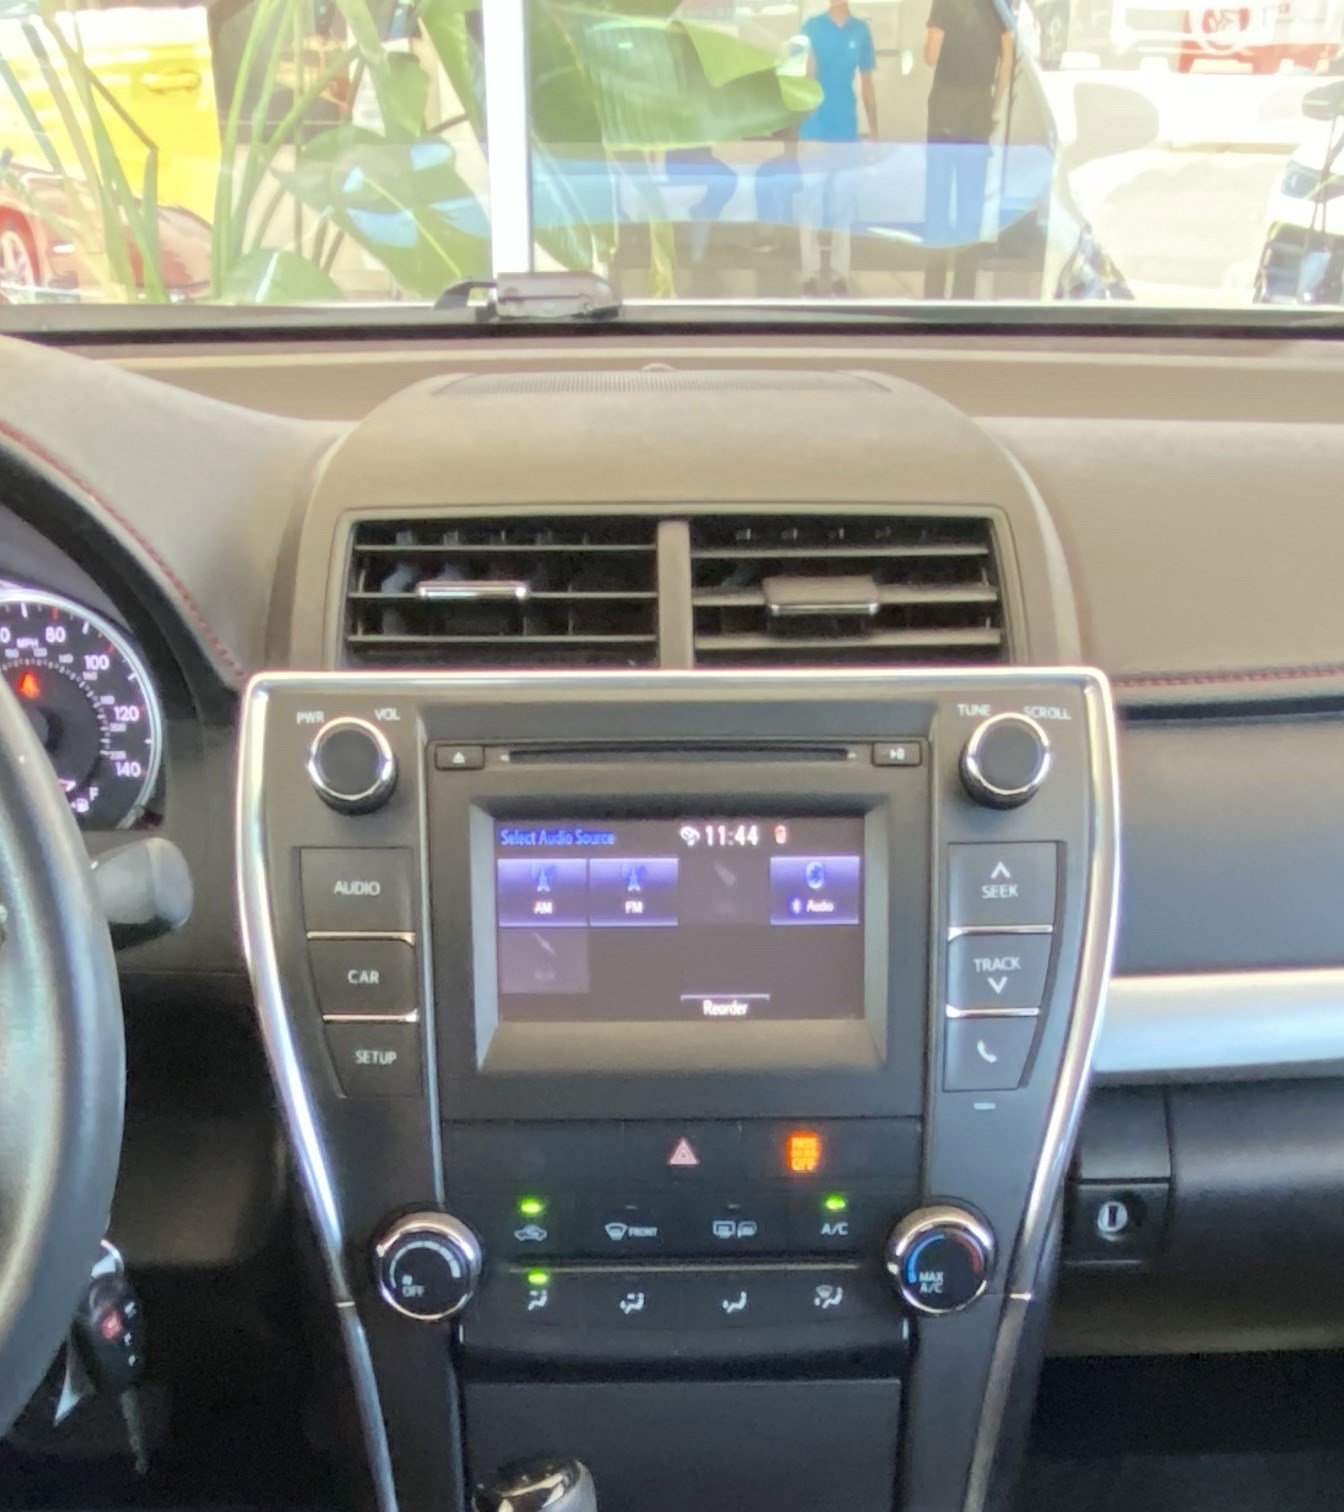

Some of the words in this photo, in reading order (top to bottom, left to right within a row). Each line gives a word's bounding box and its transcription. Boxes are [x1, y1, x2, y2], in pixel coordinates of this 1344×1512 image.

[45, 627, 66, 643] 80
[17, 638, 39, 649] MPH
[84, 655, 110, 670] 100
[114, 706, 140, 722] 120
[296, 711, 325, 725] PWR
[374, 709, 401, 722] VOL
[957, 704, 991, 717] TUNE
[1023, 706, 1071, 721] SCROLL
[115, 761, 142, 778] 140
[88, 786, 99, 801] F
[500, 829, 537, 846] Select
[538, 830, 573, 846] Audio
[574, 830, 616, 846] Source
[705, 825, 760, 847] 11:44
[334, 881, 381, 897] AUDIO
[981, 883, 1019, 899] SEEK
[533, 901, 553, 915] AM
[624, 900, 644, 914] FM
[806, 899, 835, 913] Audio
[974, 956, 1021, 973] TRACK
[347, 970, 379, 984] CAR
[702, 1000, 749, 1016] Reorder
[355, 1051, 397, 1065] SETUP
[821, 1222, 849, 1236] A/C
[919, 1271, 944, 1283] MAX
[920, 1282, 943, 1294] A/C
